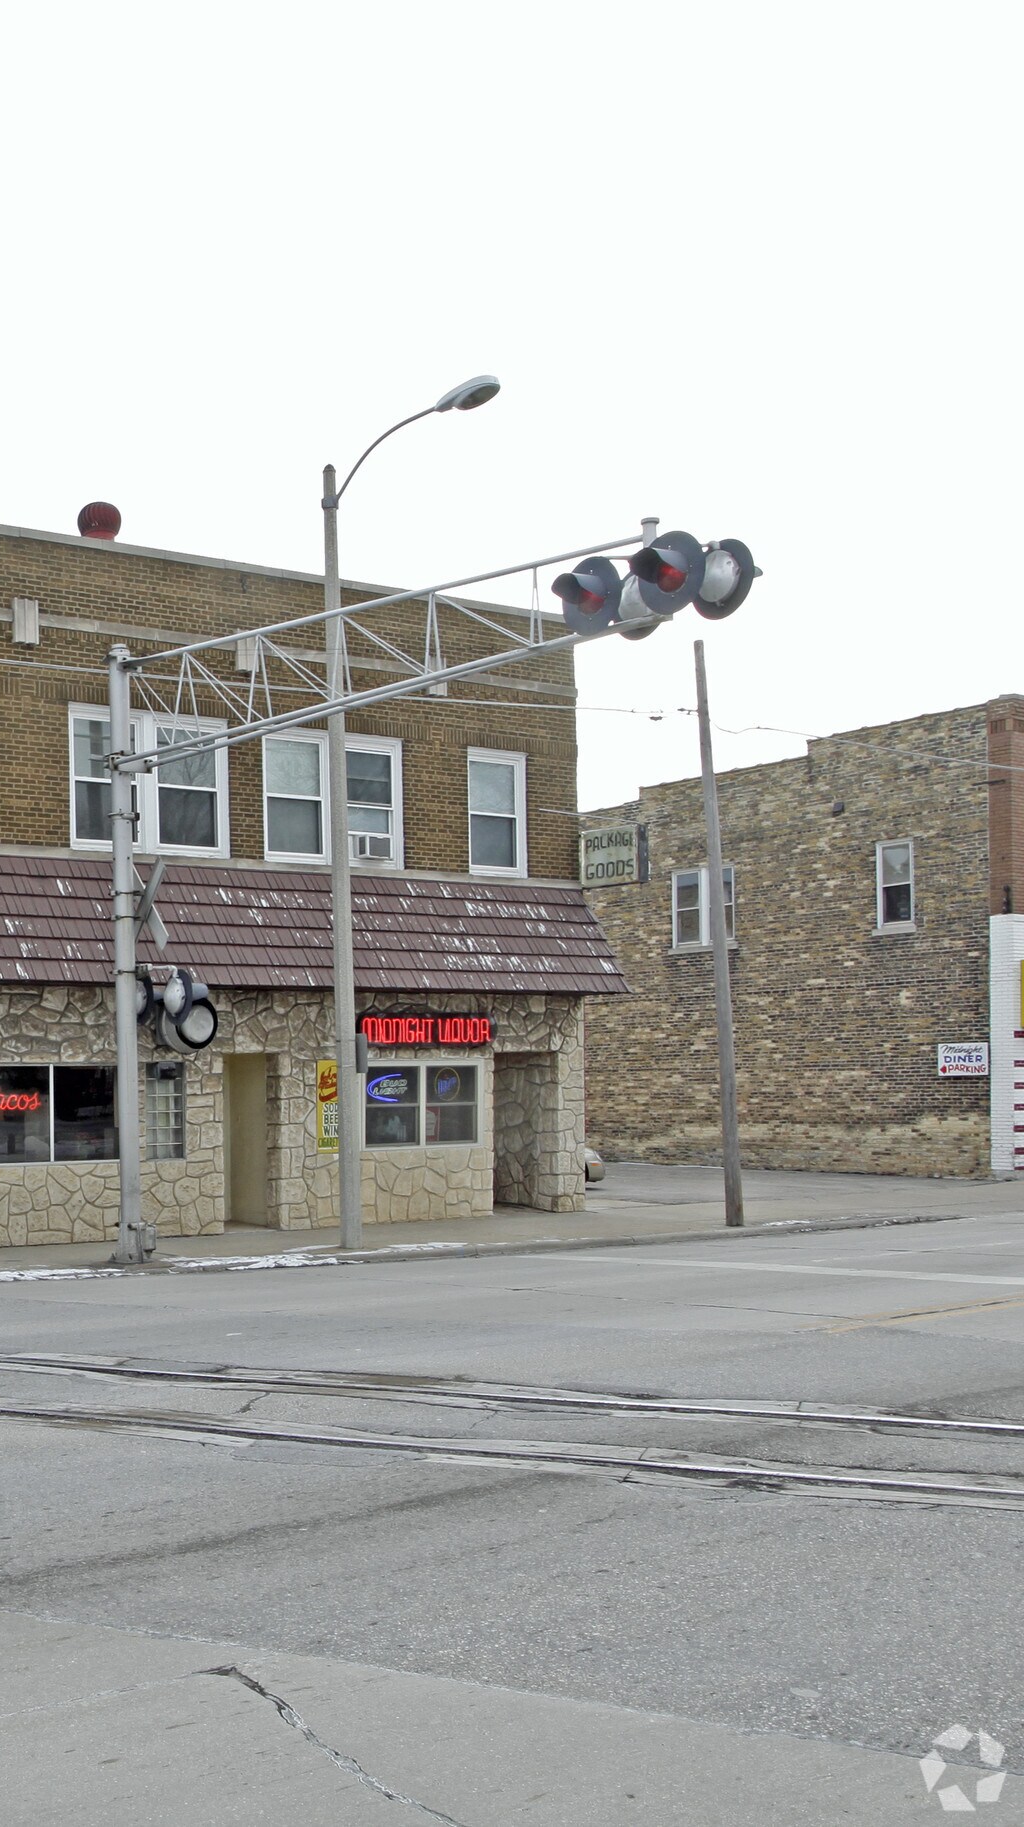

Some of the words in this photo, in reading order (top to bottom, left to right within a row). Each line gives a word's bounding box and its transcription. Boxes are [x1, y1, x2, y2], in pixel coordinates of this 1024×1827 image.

[585, 831, 635, 854] PACKAGE
[586, 858, 635, 880] GOODS
[362, 1017, 434, 1043] MIDNIGHT
[437, 1018, 491, 1043] LIQUOR
[940, 1044, 984, 1055] Midnight
[944, 1055, 983, 1063] DINER
[948, 1063, 986, 1073] PARKING
[323, 1102, 338, 1113] SOD
[323, 1114, 338, 1125] BEE
[322, 1125, 338, 1137] WIN
